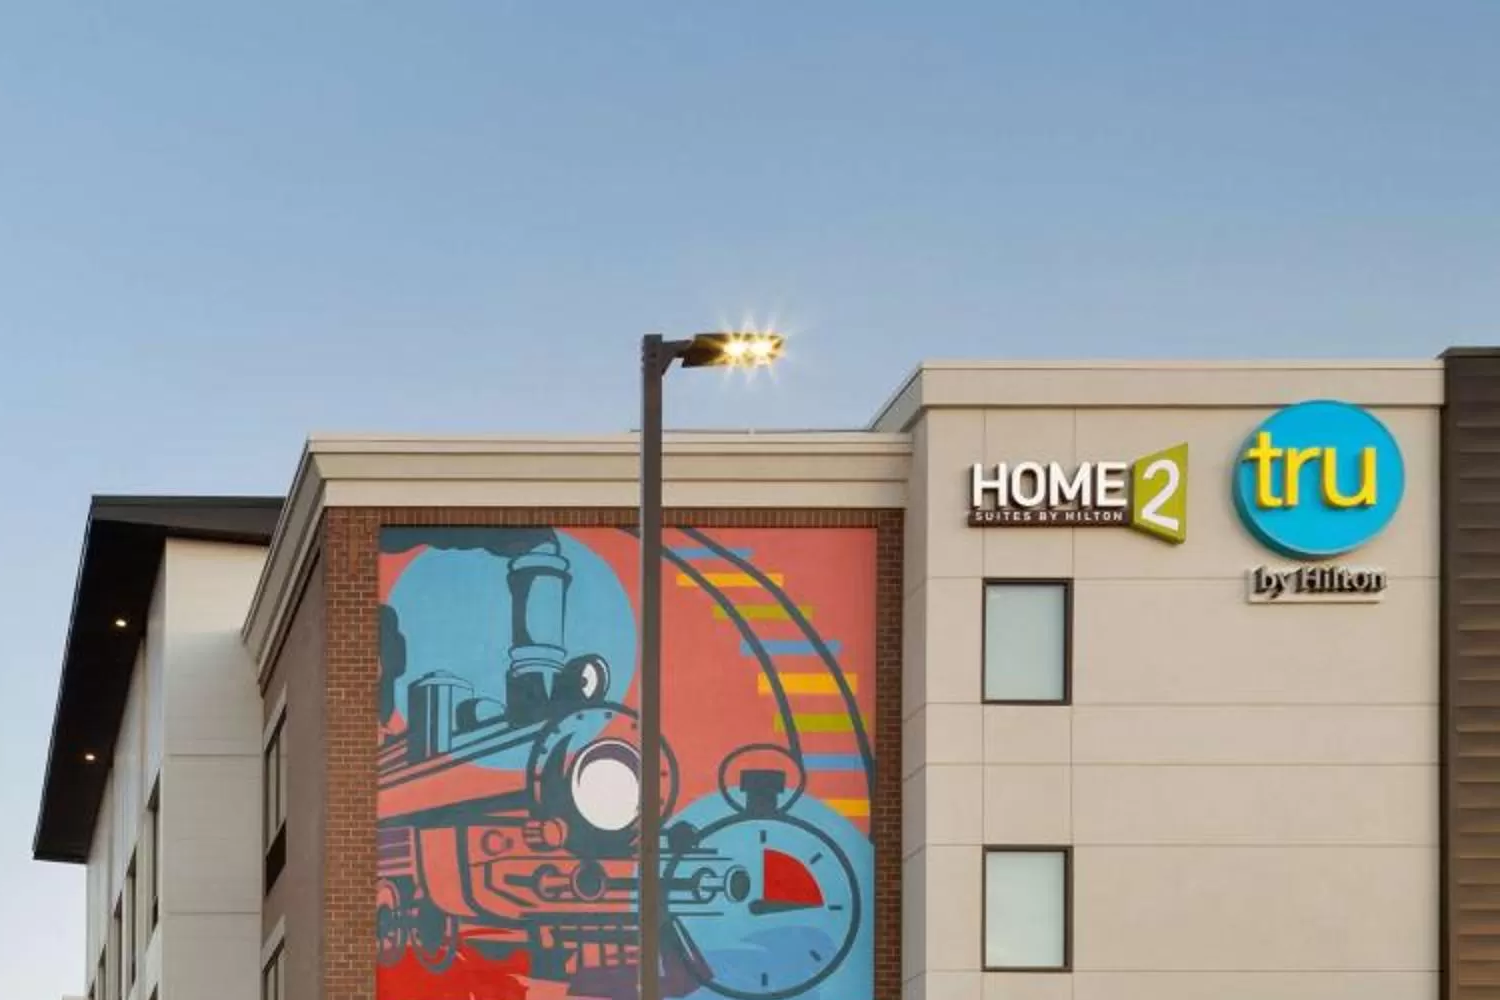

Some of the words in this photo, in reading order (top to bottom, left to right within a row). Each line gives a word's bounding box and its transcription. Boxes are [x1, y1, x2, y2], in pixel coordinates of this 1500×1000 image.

[971, 461, 1128, 508] HOME
[1244, 431, 1378, 509] tru
[974, 511, 1032, 522] SUITES
[1039, 511, 1058, 522] BY
[1064, 511, 1124, 522] HILTON
[1253, 565, 1293, 600] by
[1294, 565, 1388, 594] Hilton
